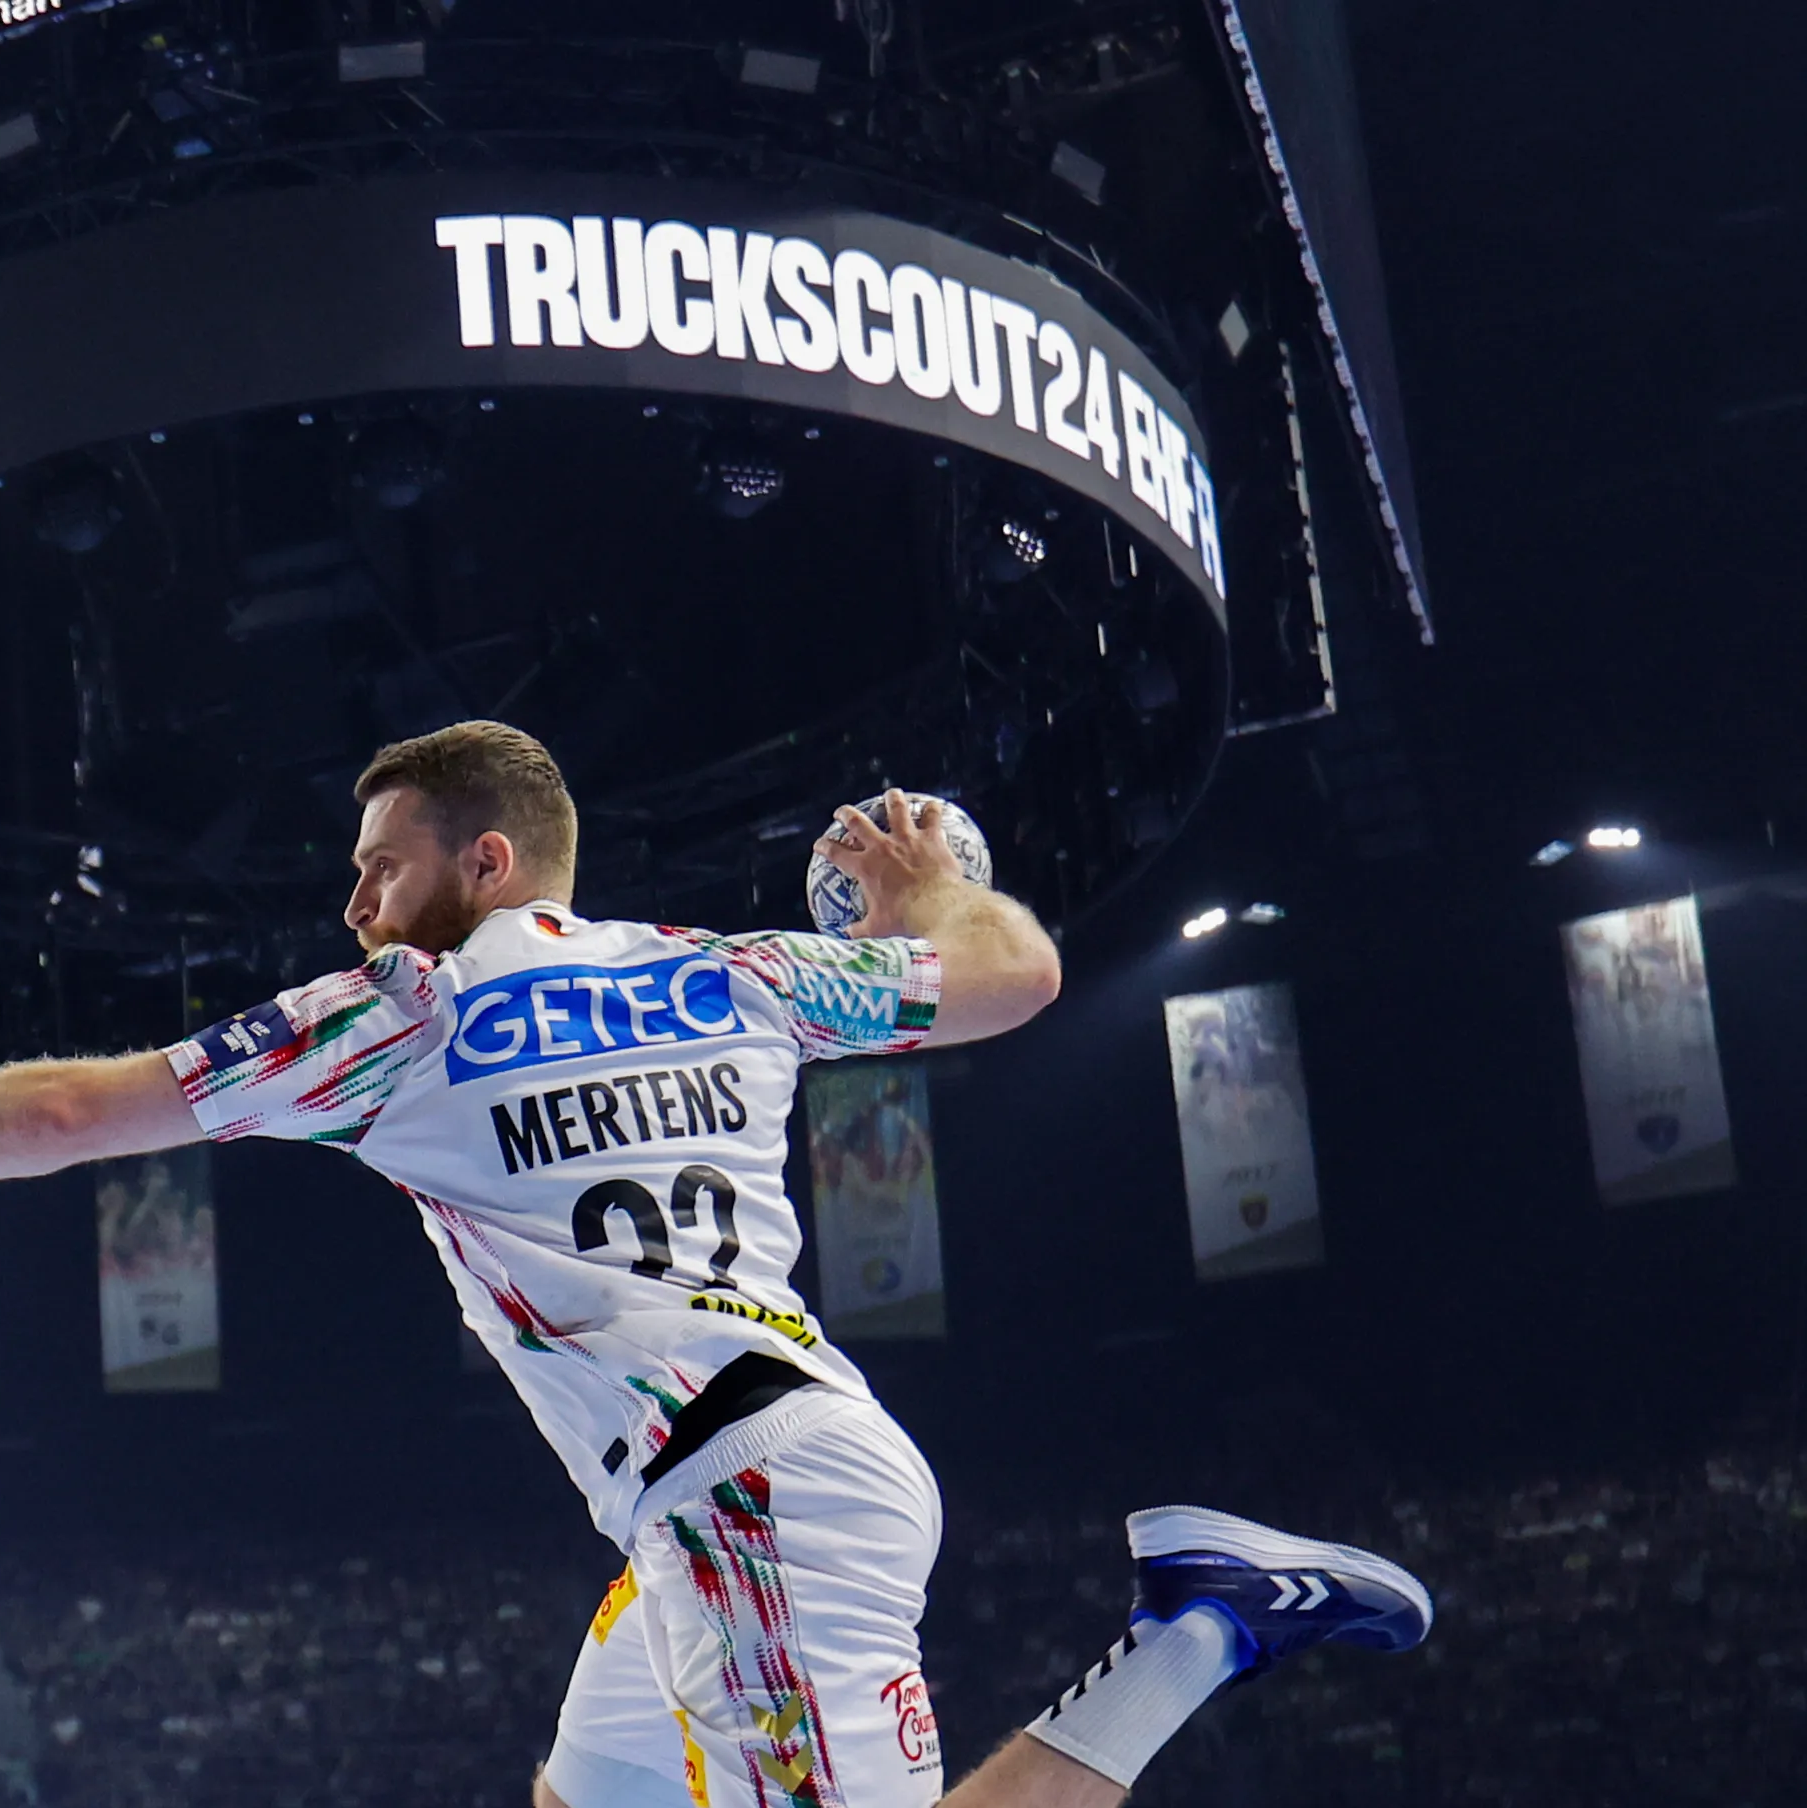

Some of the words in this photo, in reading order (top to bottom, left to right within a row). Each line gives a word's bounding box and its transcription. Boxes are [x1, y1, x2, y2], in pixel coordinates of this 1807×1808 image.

[435, 215, 1119, 480] TRUCKSCOUT24
[1118, 369, 1194, 550] EHF
[453, 959, 737, 1064] GETEC
[490, 1063, 746, 1175] MERTENS
